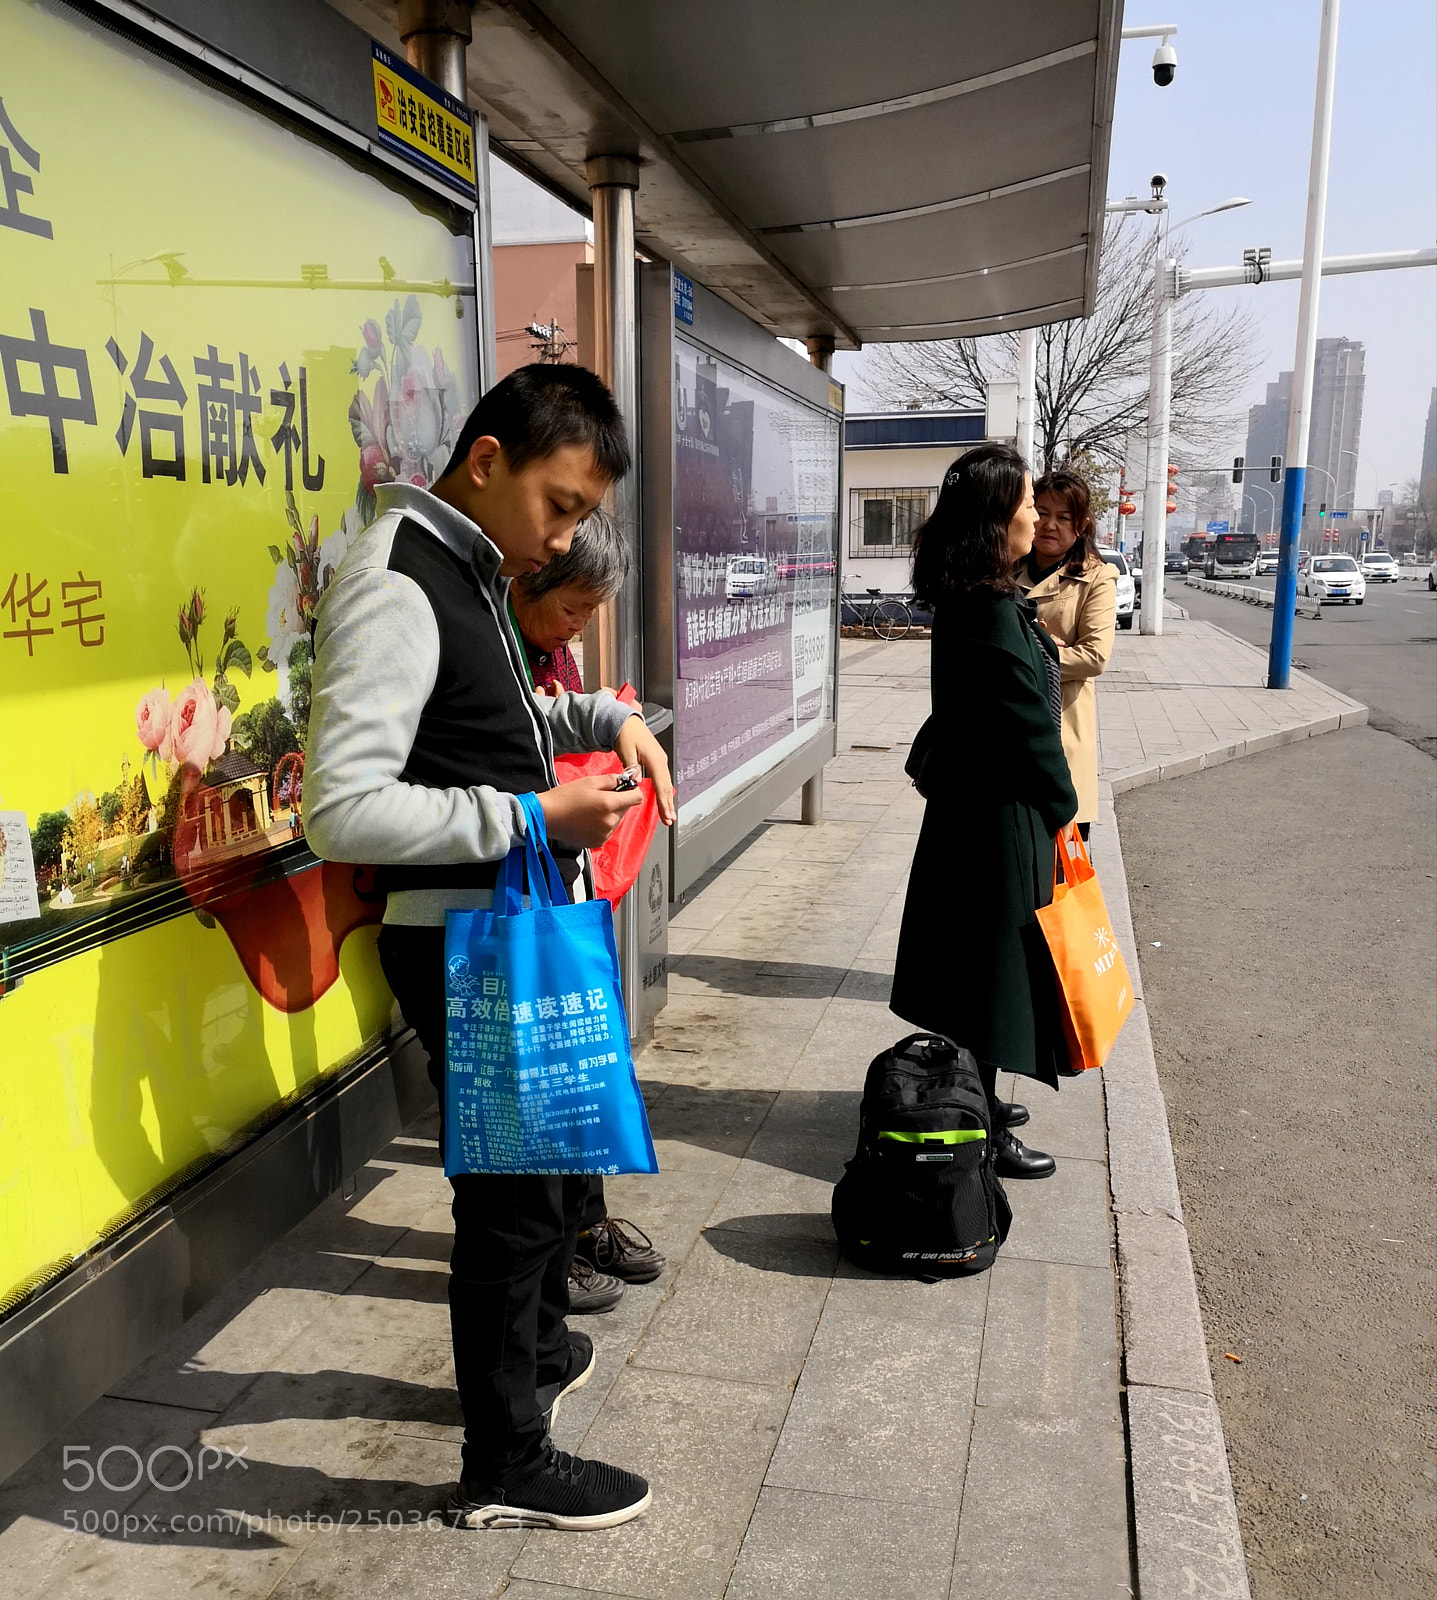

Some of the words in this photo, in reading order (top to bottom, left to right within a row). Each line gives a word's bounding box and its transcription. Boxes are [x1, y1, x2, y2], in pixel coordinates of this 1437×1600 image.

[397, 87, 472, 172] 治安监控覆盖区域
[0, 307, 326, 492] 中冶献礼
[0, 570, 106, 657] 华宅
[446, 987, 608, 1025] 高效倍速读速记
